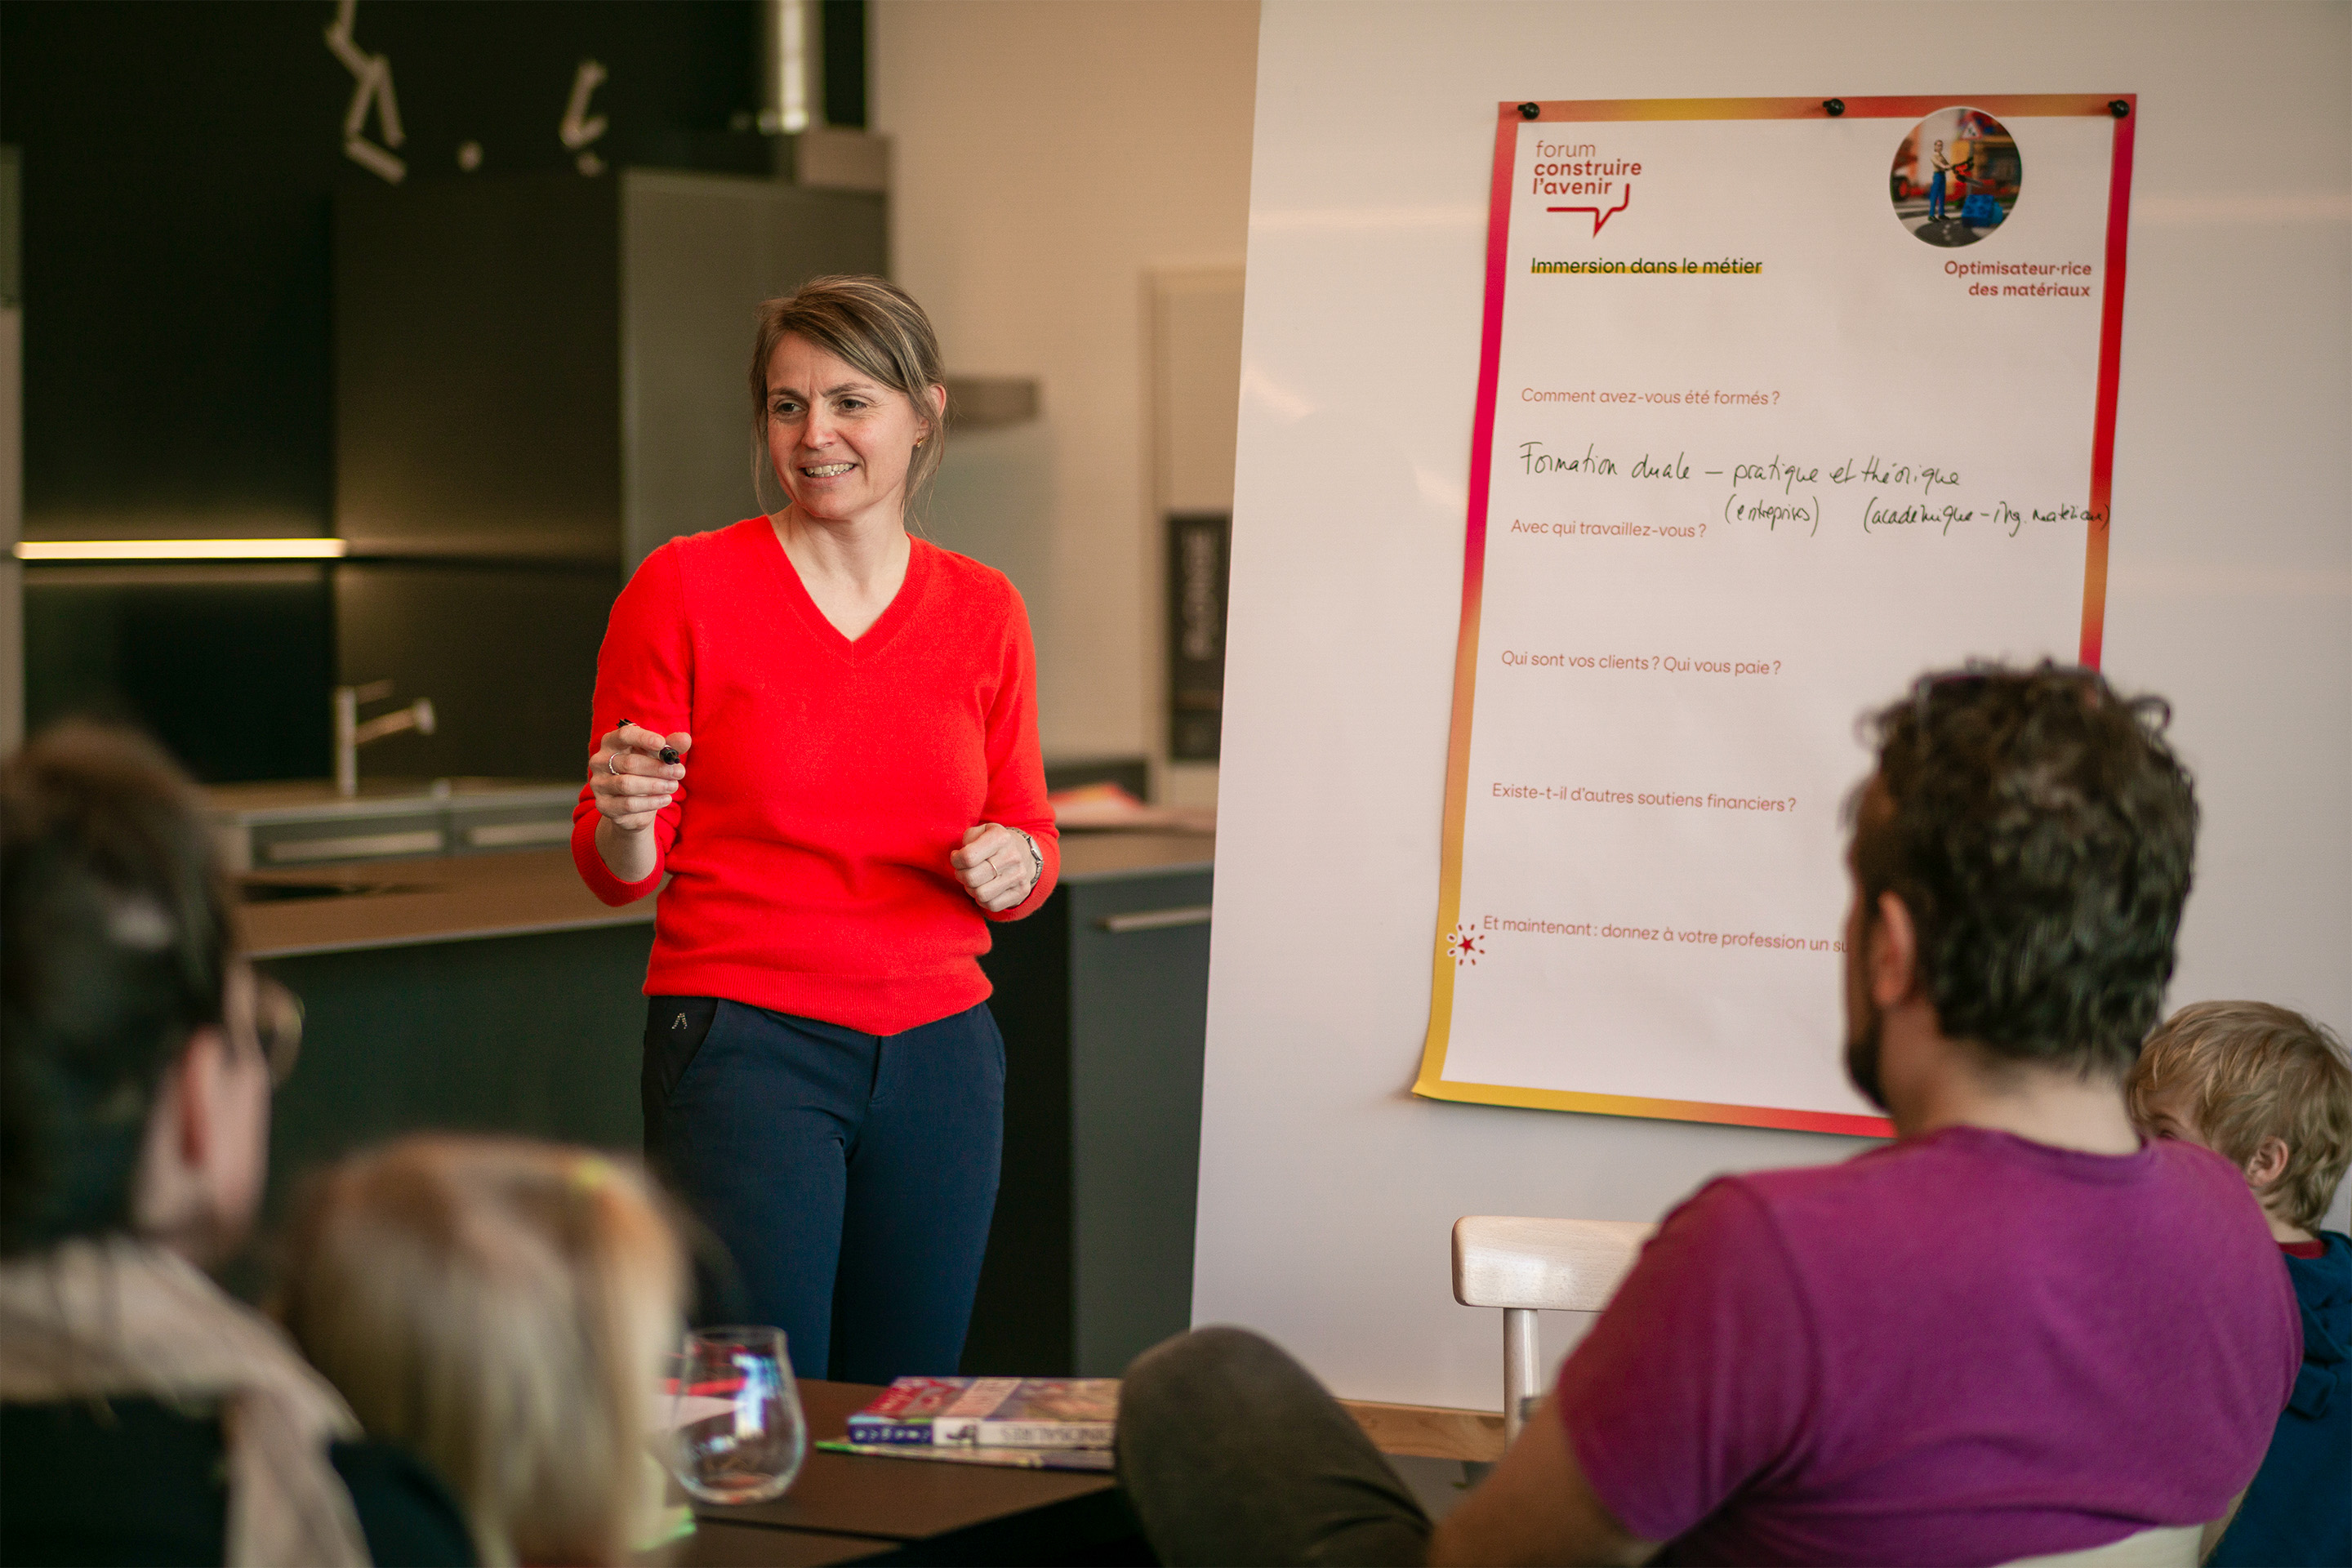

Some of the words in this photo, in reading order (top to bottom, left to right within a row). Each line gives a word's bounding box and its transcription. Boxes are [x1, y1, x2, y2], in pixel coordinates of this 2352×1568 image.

[1536, 140, 1596, 158] forum
[1535, 158, 1642, 176] construire
[1530, 257, 1628, 274] Immersion
[1628, 258, 1679, 274] dans
[1680, 258, 1700, 274] le
[1700, 257, 1762, 274] métier
[1969, 282, 1998, 296] des
[2003, 283, 2090, 296] matériaux
[1521, 388, 1596, 403] Comment
[1599, 391, 1681, 404] avez-vous
[1685, 390, 1709, 404] été
[1714, 390, 1768, 405] formés
[1520, 442, 1618, 475] Formation
[1632, 452, 1689, 479] duale
[1732, 455, 1818, 495] pratique
[1829, 458, 1856, 483] et
[1511, 519, 1548, 533] Avec
[1552, 520, 1576, 537] qui
[1579, 522, 1695, 537] travaillez-vous
[1502, 650, 1527, 666] Qui
[1531, 653, 1565, 666] sont
[1569, 657, 1595, 668] vos
[1599, 655, 1649, 670] clients
[1664, 657, 1690, 673] Qui
[1695, 662, 1731, 673] vous
[1735, 660, 1770, 676] paie
[1493, 782, 1567, 800] Existe-t-il
[1571, 787, 1633, 804] d'autres
[1638, 792, 1703, 808] soutiens
[1708, 794, 1785, 812] financiers
[1484, 915, 1499, 930] Et
[1503, 918, 1592, 936] maintenant
[1601, 924, 1659, 940] donnez
[1664, 927, 1673, 941] à
[1678, 930, 1718, 944] votre
[1722, 932, 1806, 950] profession
[1810, 939, 1829, 951] un
